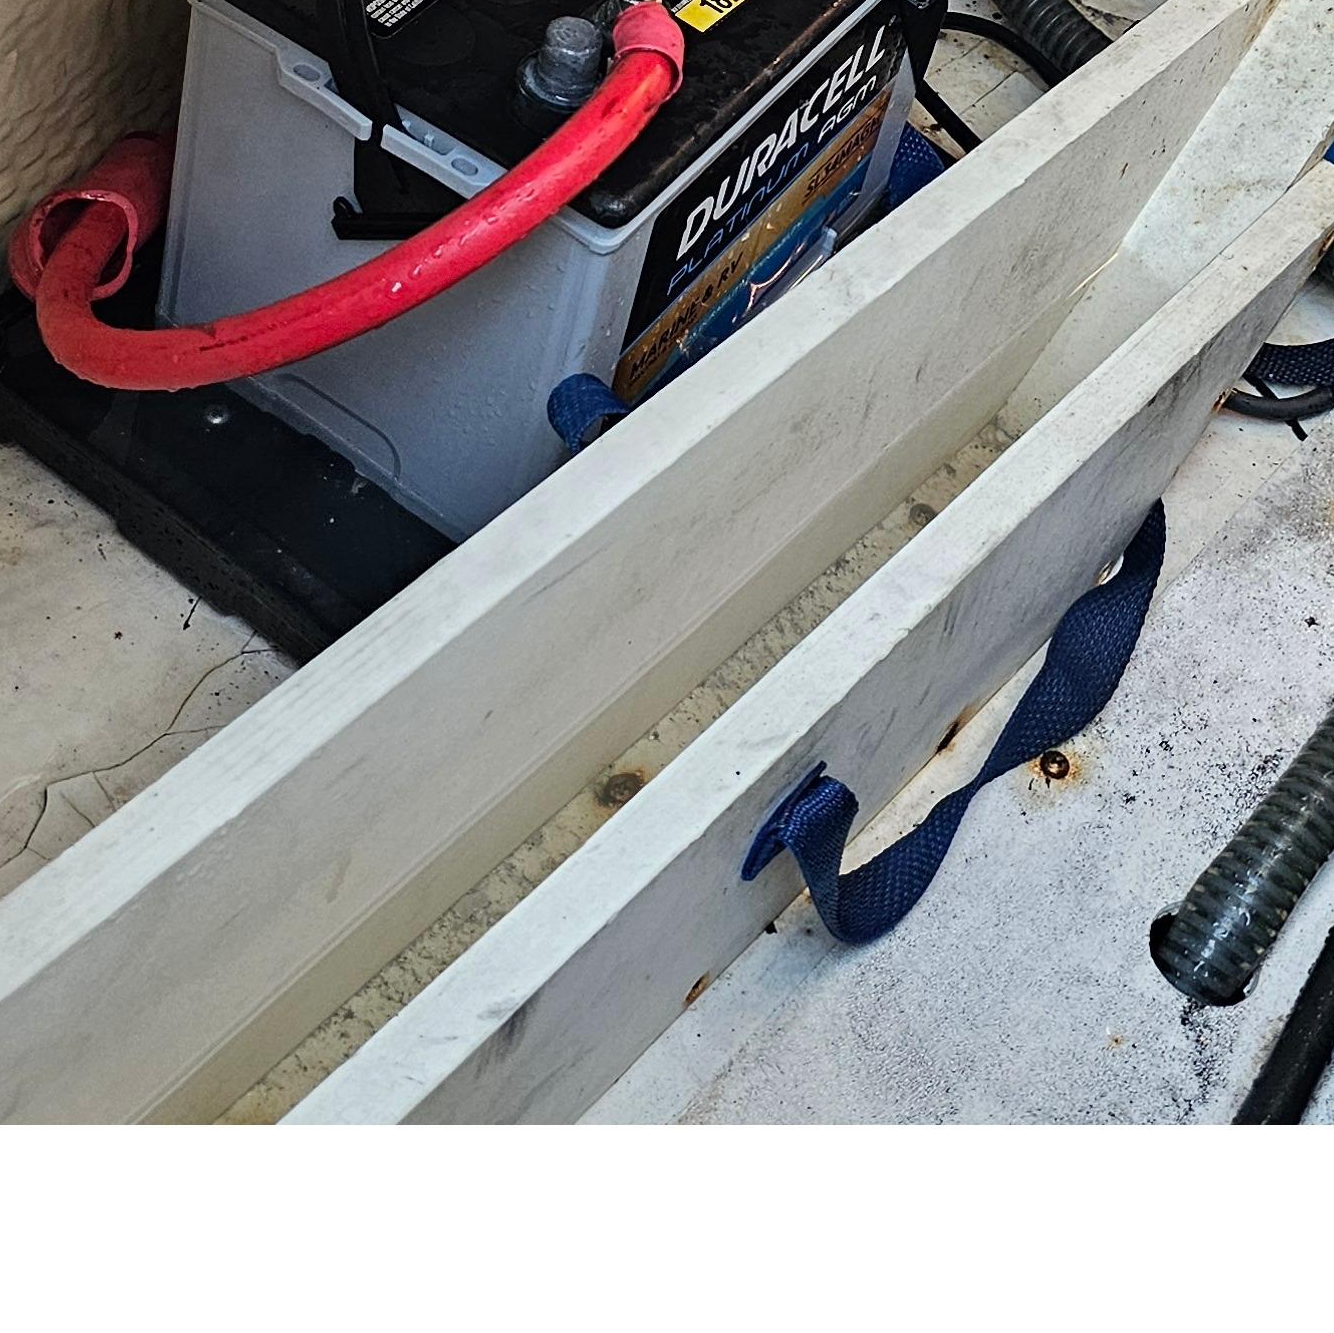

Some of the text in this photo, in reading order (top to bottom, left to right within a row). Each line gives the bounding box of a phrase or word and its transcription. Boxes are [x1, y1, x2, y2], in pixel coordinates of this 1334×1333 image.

[666, 71, 877, 297] PLATINUM AGM
[674, 15, 889, 264] DURACELL
[628, 249, 744, 382] MARINE & RV
